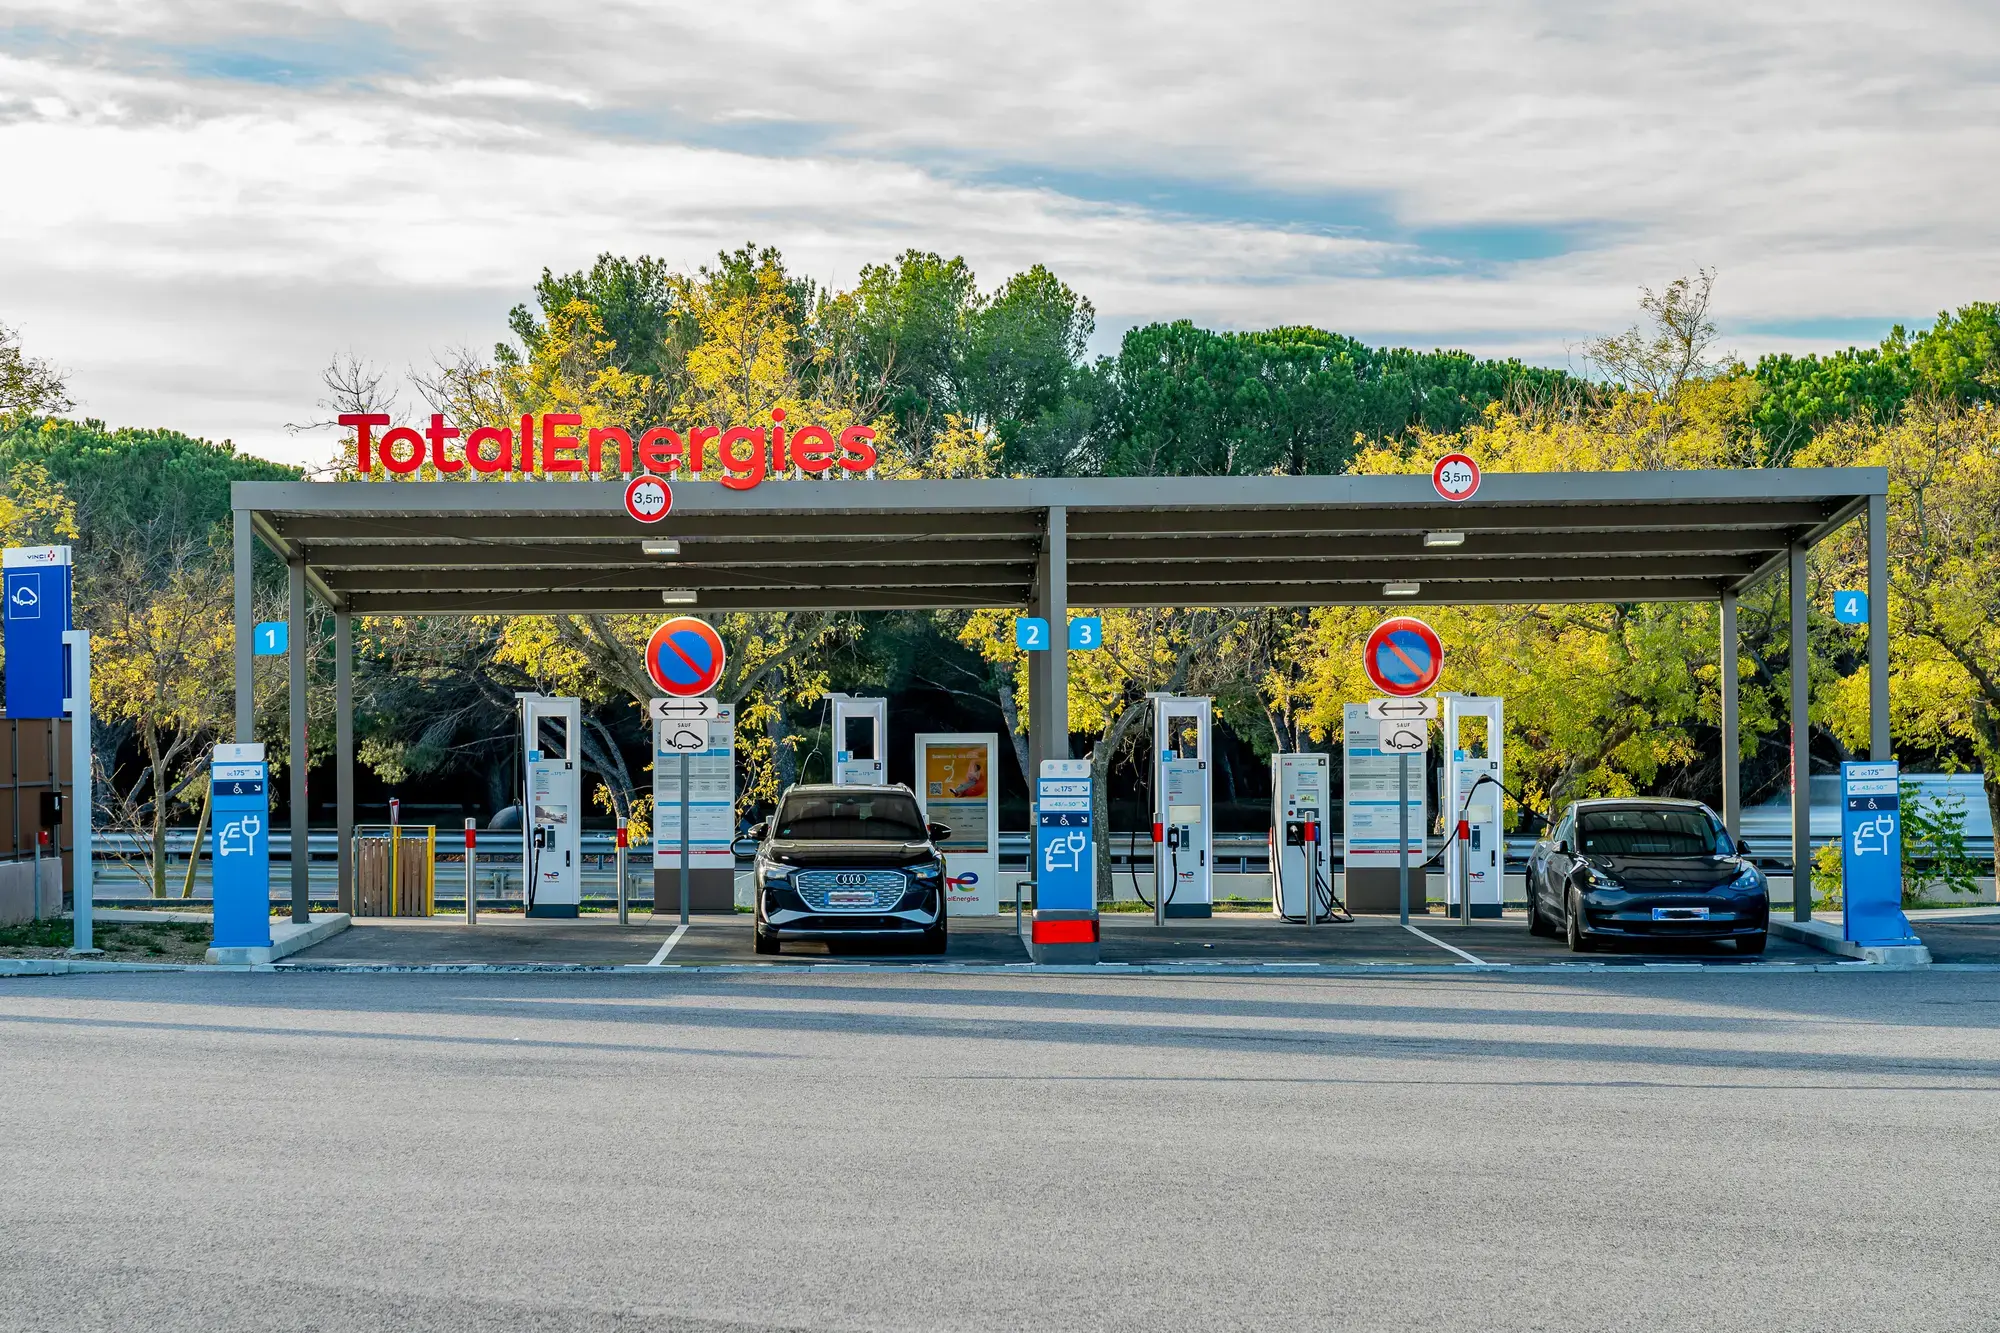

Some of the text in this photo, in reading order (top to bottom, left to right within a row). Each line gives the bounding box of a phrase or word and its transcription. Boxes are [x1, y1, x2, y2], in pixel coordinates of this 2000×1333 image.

[338, 408, 877, 490] TotalEnergies
[1442, 471, 1471, 484] 3,5m
[634, 492, 664, 505] 3,5m
[1844, 597, 1859, 617] 4
[265, 629, 275, 649] 1
[1026, 625, 1040, 645] 2
[1079, 624, 1092, 644] 3
[947, 895, 980, 903] alEnergies
